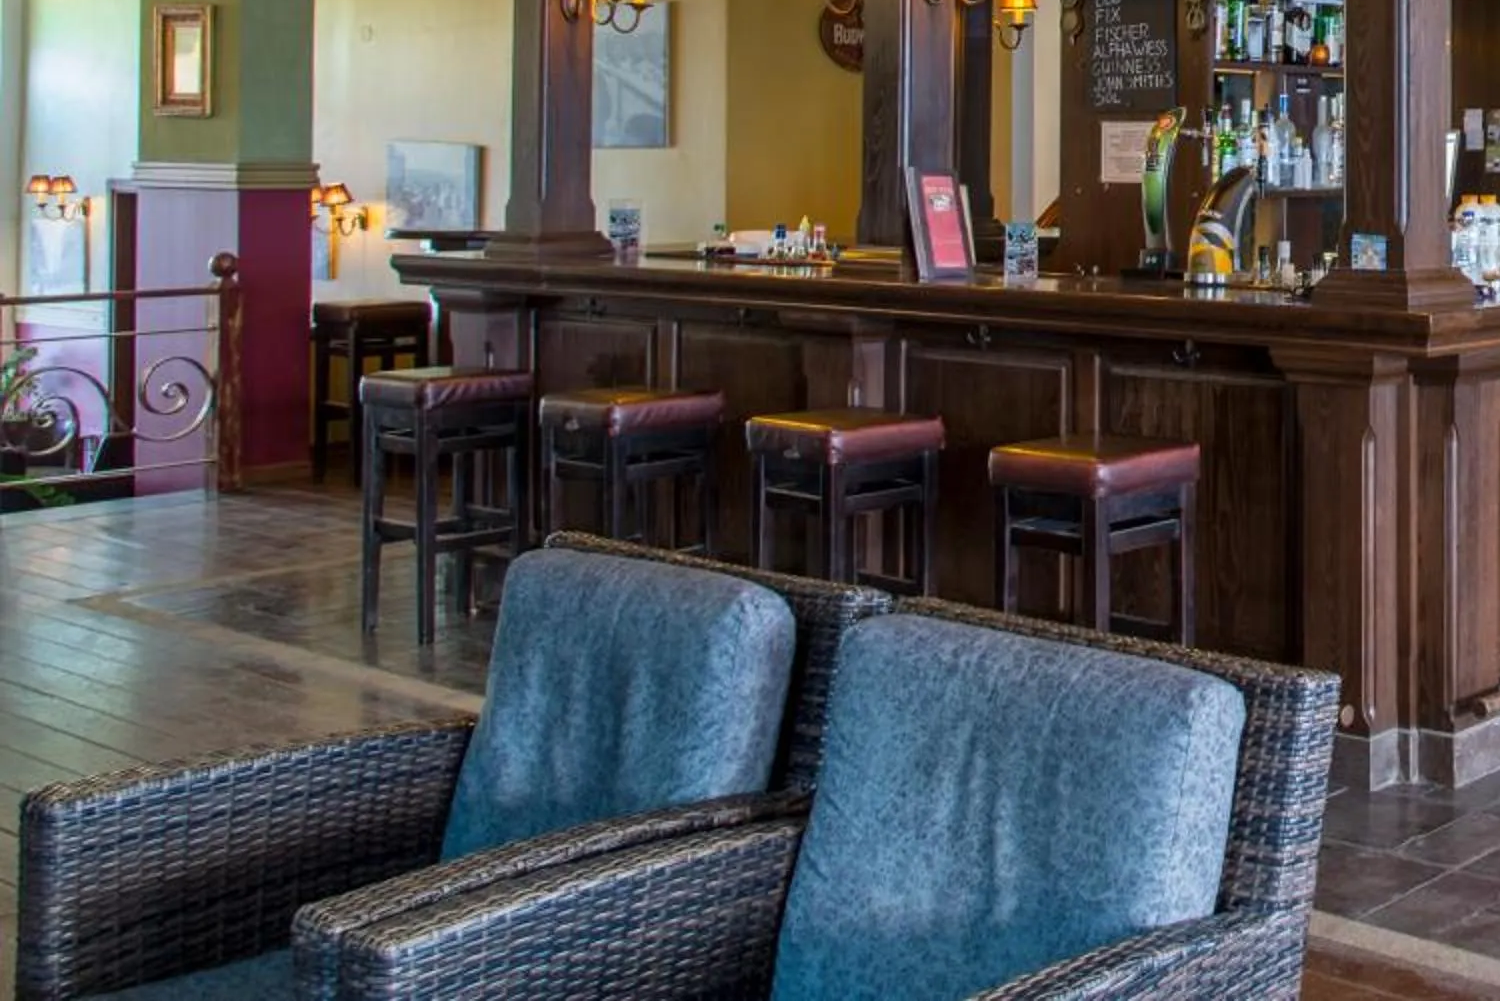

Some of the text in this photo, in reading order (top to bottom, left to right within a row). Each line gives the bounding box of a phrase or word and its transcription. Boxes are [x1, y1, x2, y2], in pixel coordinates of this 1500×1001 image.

[1094, 6, 1121, 24] FIX
[1095, 23, 1150, 43] FISCHER
[1092, 57, 1161, 76] GUINNESS
